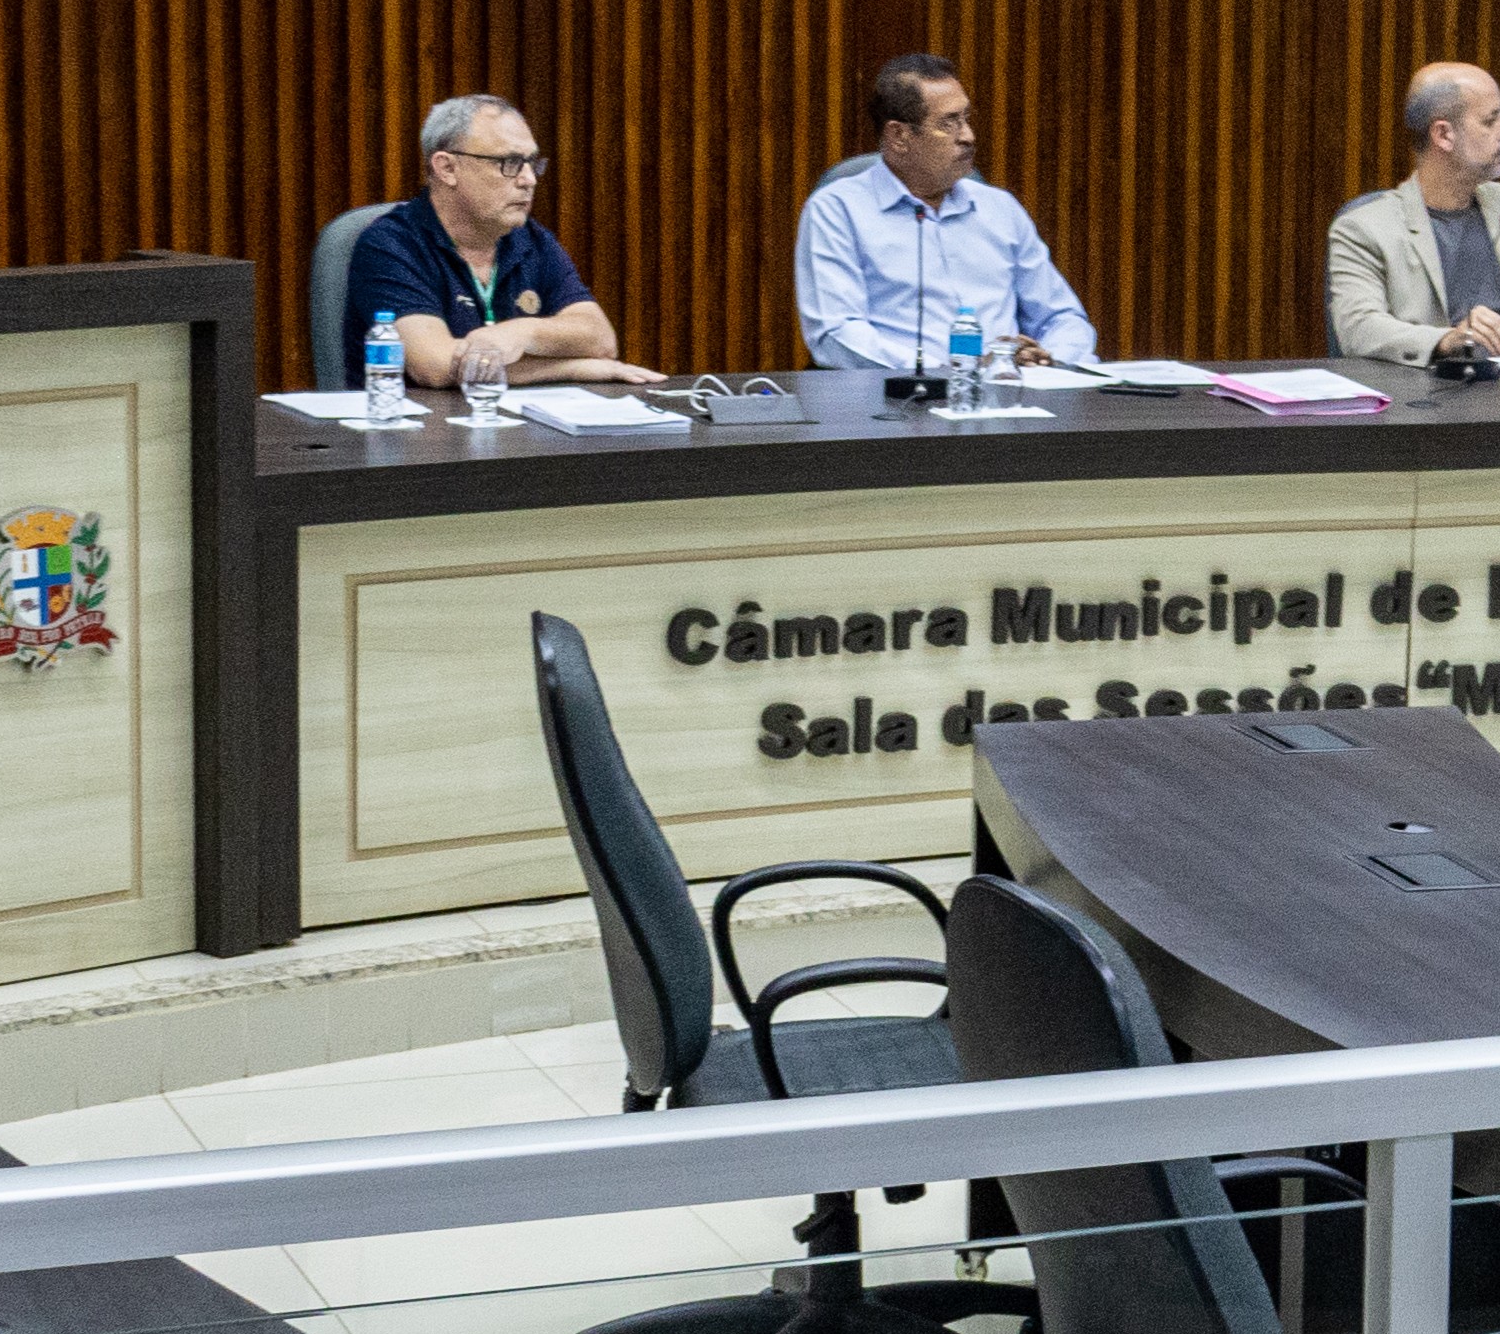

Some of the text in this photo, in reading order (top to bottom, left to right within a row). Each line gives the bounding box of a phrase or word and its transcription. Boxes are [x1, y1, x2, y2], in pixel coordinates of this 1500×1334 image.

[664, 600, 969, 666] Câmara
[989, 572, 1345, 645] Municipal
[1368, 568, 1461, 626] de
[756, 697, 918, 761] Sala
